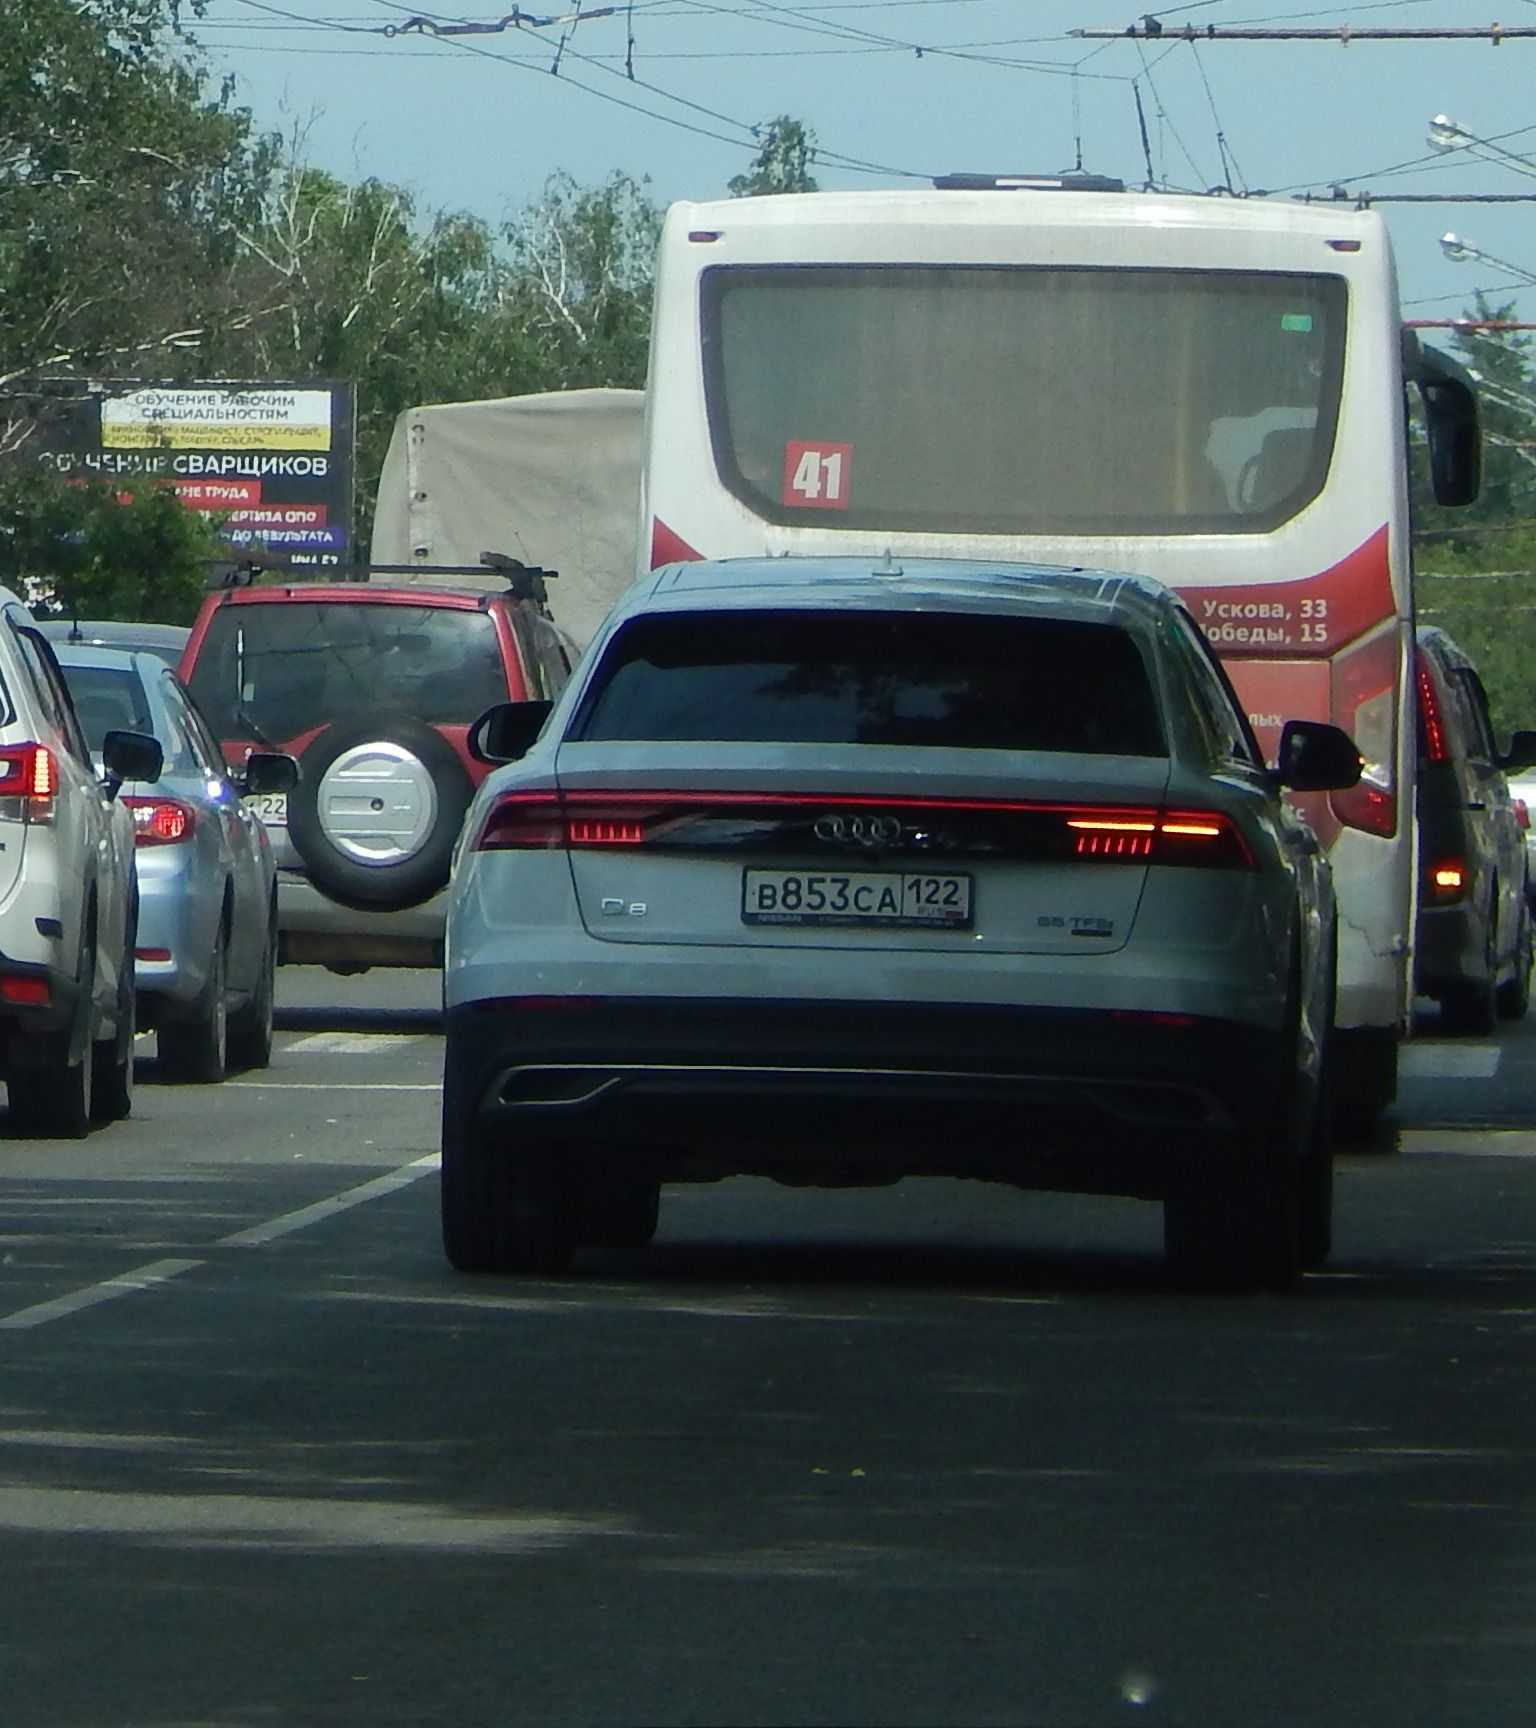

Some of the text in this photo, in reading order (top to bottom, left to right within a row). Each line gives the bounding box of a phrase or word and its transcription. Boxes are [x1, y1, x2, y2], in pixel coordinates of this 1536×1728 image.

[135, 393, 296, 407] ОБУЧЕНИЕ РАБОЧИМ
[141, 407, 289, 421] СПЕЦИАЛЬНОСТЯМ
[173, 454, 328, 477] СВАРЩИКОВ
[793, 451, 841, 499] 41
[205, 487, 249, 499] ТРУДА
[1203, 599, 1328, 620] Ускова, 33
[1300, 624, 1328, 642] 15
[758, 876, 959, 913] В853СА 122
